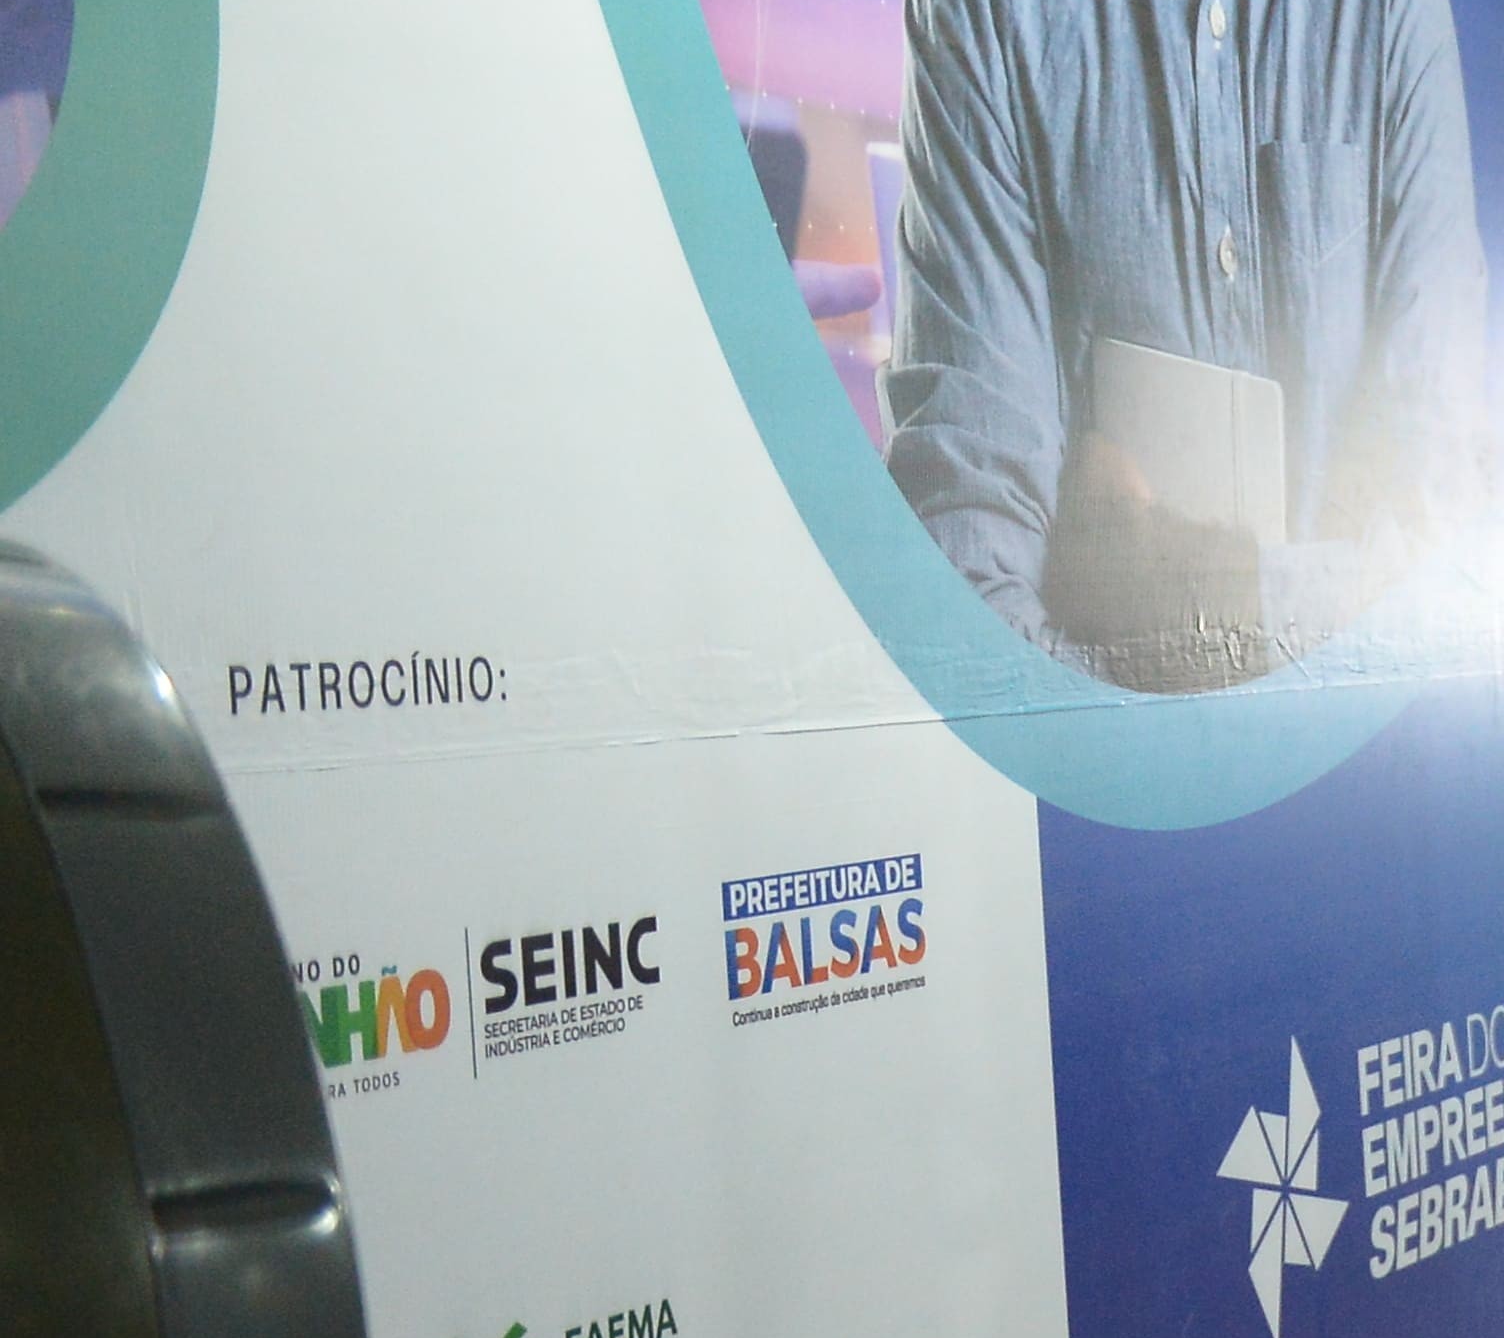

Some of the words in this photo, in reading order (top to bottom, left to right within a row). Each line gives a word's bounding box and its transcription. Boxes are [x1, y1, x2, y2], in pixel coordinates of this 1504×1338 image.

[228, 651, 510, 716] PATROCÍNIO:
[729, 862, 882, 918] PREFEITURA
[884, 857, 917, 892] DE
[332, 954, 361, 978] DO
[479, 915, 661, 1015] SEINC
[725, 897, 927, 1001] BALSAS
[484, 1012, 558, 1040] SECRETARIA
[561, 1007, 578, 1025] DE
[580, 998, 626, 1021] ESTADO
[628, 995, 644, 1012] DE
[484, 1033, 551, 1059] INDÚSTRIA
[553, 1029, 561, 1045] E
[563, 1016, 626, 1043] COMÉRCIO
[353, 1072, 400, 1094] TODOS
[1357, 1021, 1463, 1117] FEIRA
